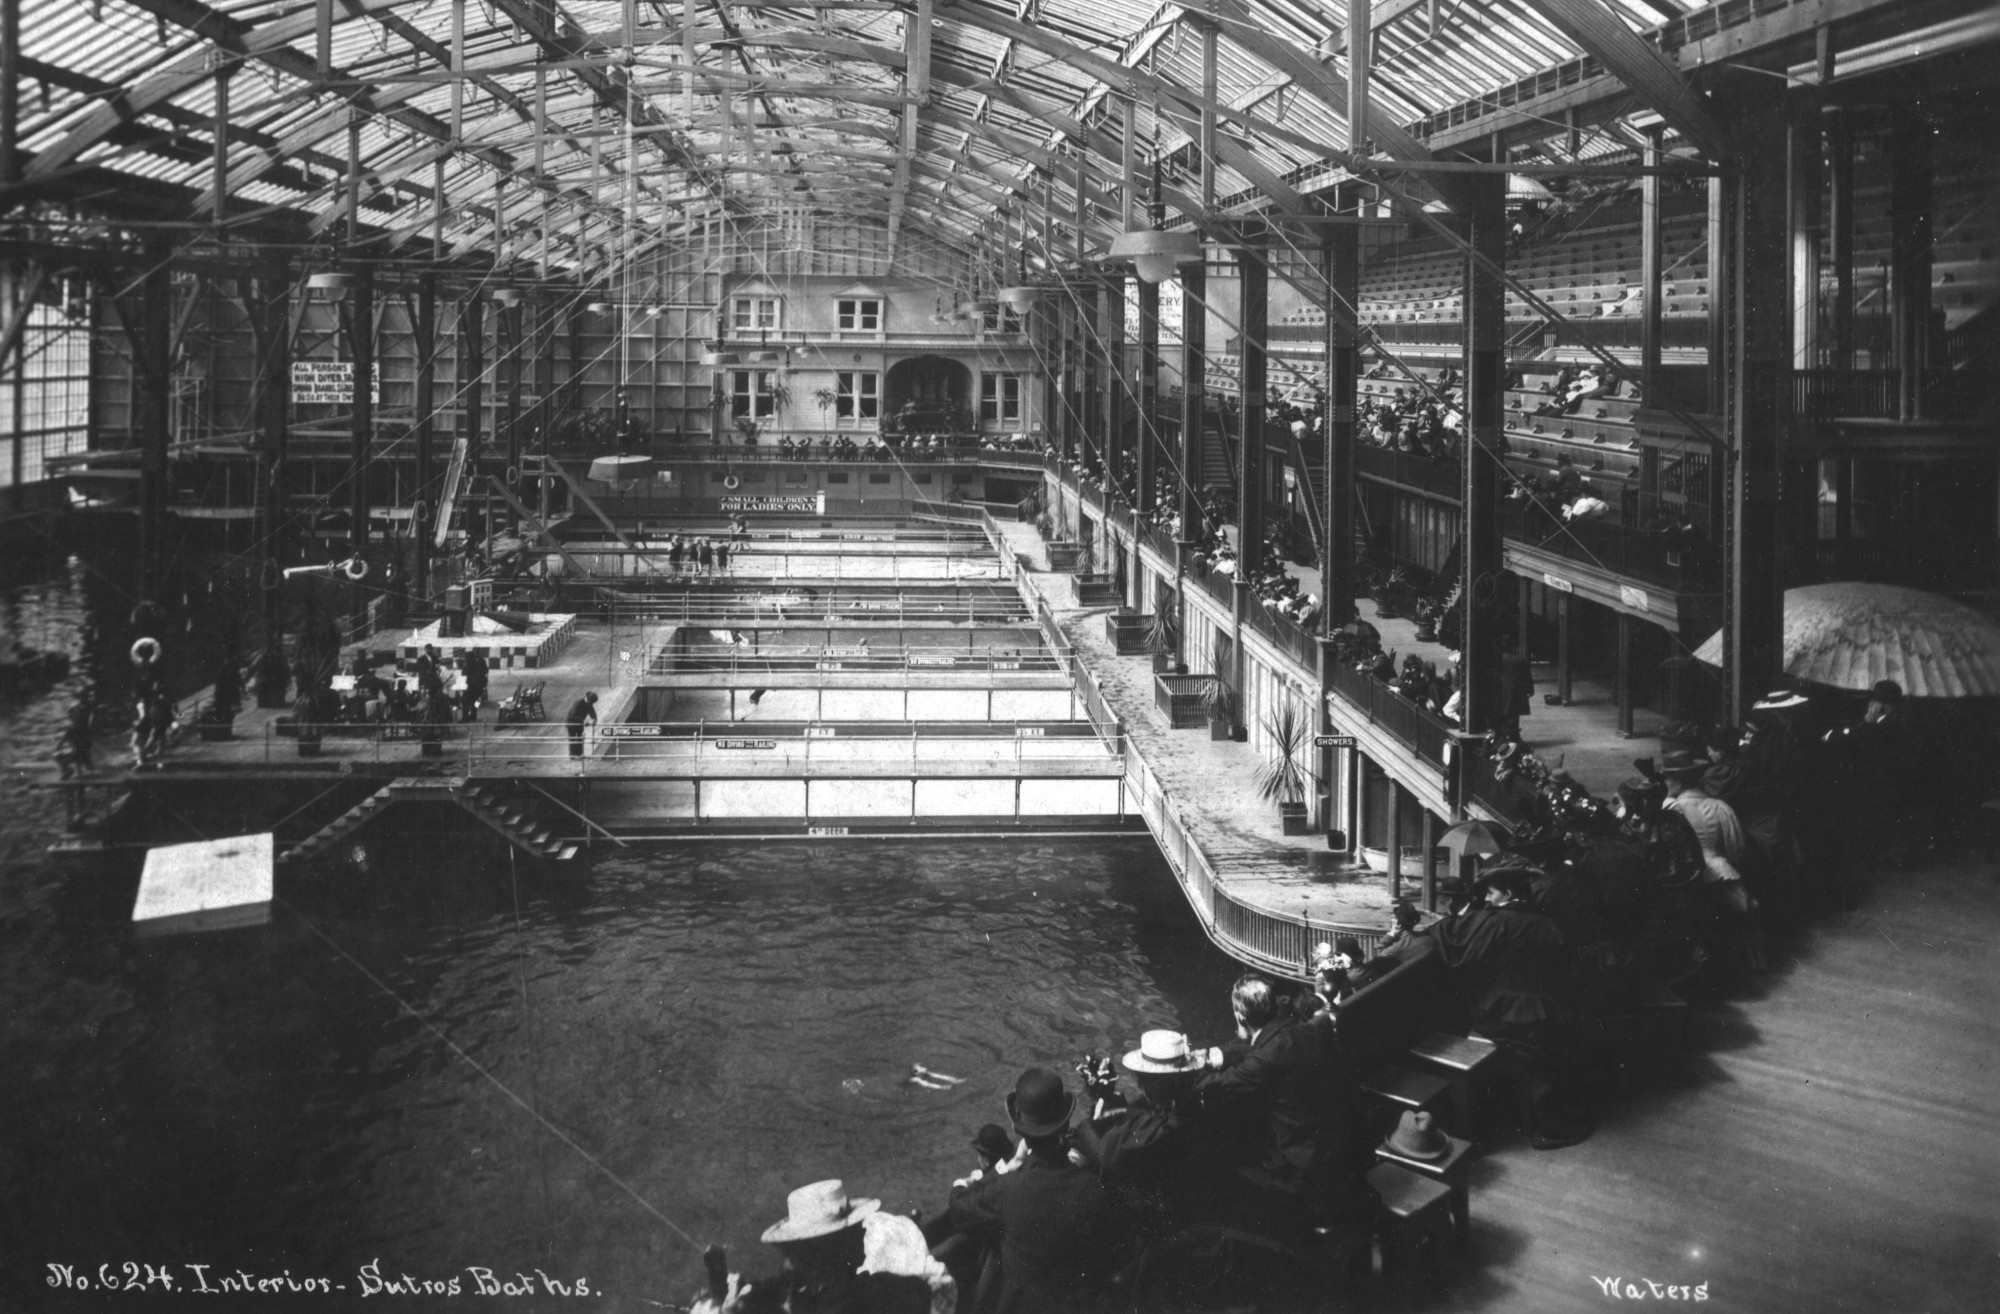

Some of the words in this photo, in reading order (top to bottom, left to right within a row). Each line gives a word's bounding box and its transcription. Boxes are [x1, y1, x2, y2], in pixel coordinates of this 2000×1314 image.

[294, 363, 309, 372] ALL
[311, 363, 347, 372] PERSONS
[295, 373, 315, 382] HIGH
[721, 503, 741, 511] FOR
[717, 740, 725, 748] NO
[727, 740, 744, 748] DIVING
[754, 740, 775, 748] RAILING
